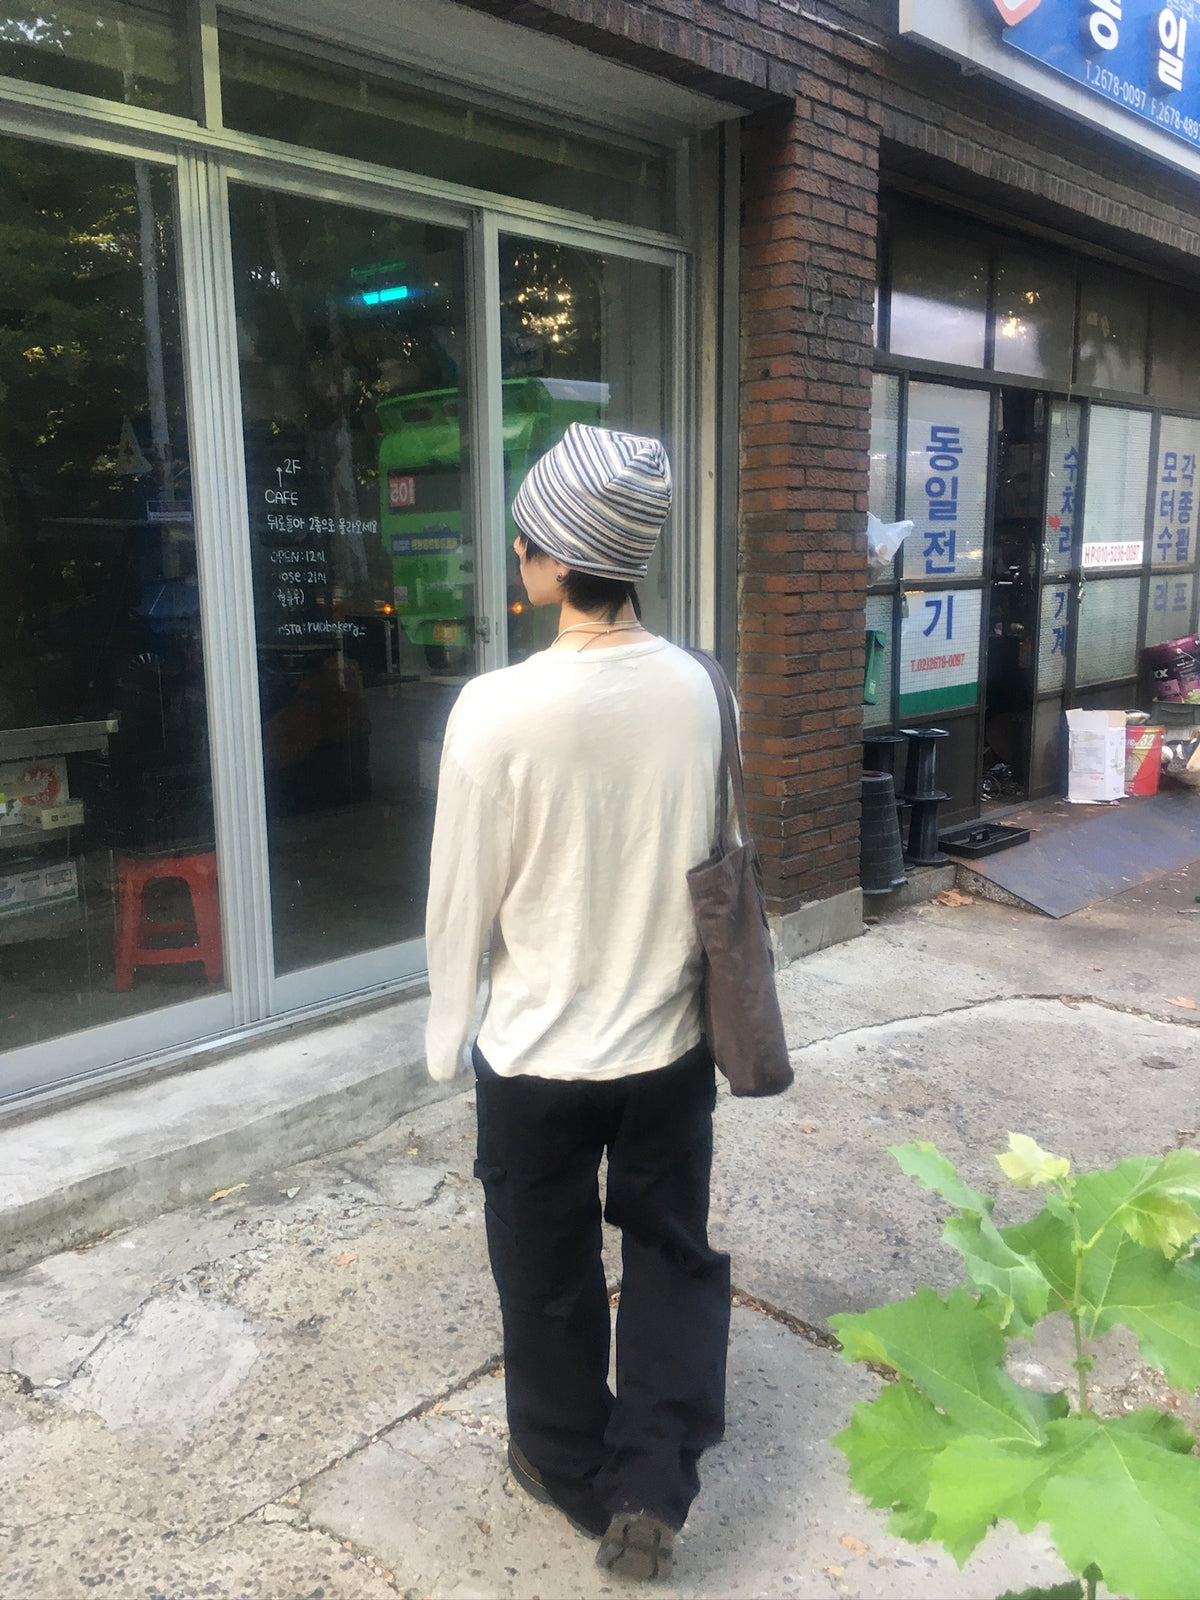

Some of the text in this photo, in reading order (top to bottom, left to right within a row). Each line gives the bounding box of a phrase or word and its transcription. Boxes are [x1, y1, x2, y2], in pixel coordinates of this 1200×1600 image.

[1085, 59, 1147, 110] T.2678-0097
[284, 458, 302, 475] 2F
[264, 489, 299, 506] CAFE
[266, 514, 378, 536] 뒤로돌아 2층으로 올라오세요
[922, 425, 963, 641] 동일전기
